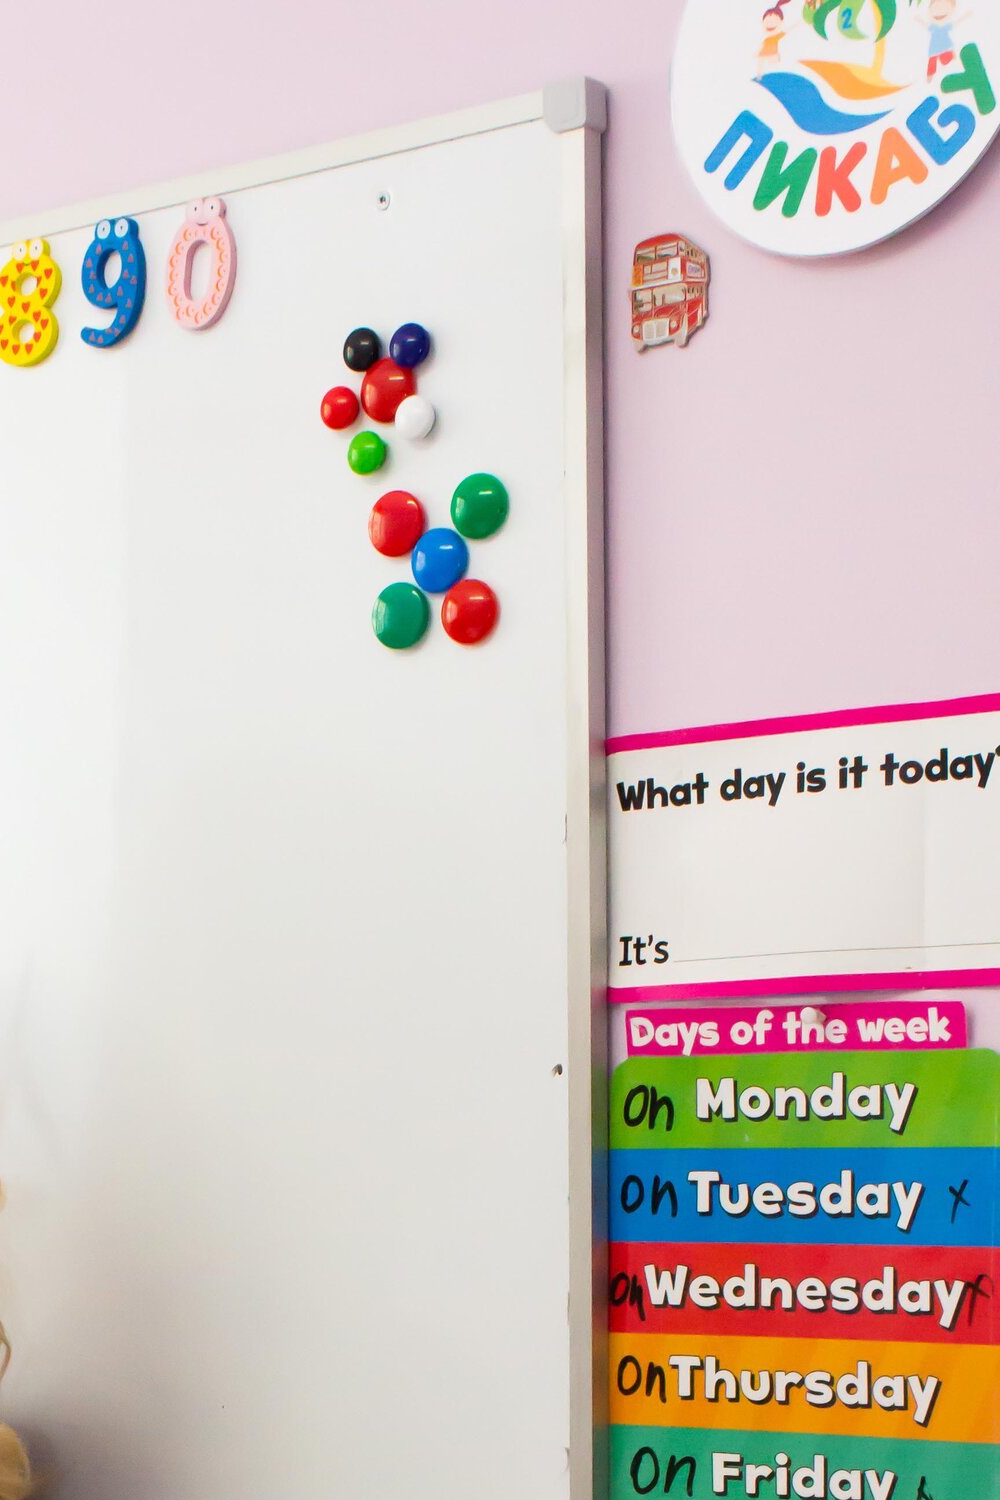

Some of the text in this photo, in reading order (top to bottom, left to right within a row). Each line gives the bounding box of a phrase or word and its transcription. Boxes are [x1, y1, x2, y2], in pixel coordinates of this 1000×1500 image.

[704, 43, 996, 218] ПИКАБУ
[617, 745, 1000, 812] What day is it today
[619, 934, 669, 966] It's
[630, 1007, 952, 1056] Days of the week
[696, 1072, 918, 1135] Monday
[688, 1169, 925, 1233] Tuesday
[644, 1263, 966, 1332] Wednesday
[668, 1355, 941, 1427] Thursday
